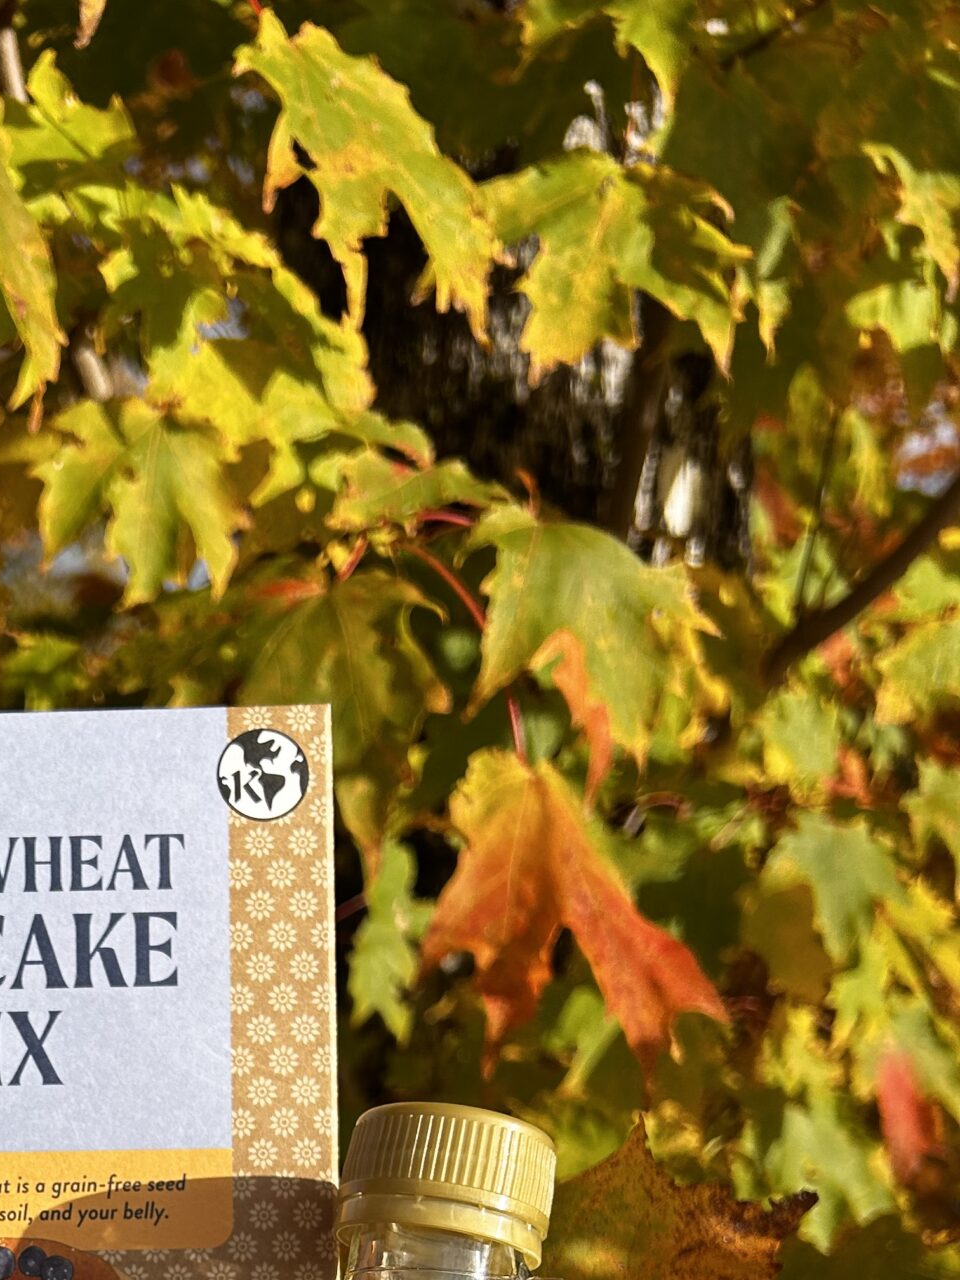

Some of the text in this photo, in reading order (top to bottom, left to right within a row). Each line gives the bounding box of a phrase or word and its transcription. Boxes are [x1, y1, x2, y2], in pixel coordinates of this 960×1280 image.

[16, 1176, 30, 1194] is
[35, 1182, 46, 1194] a
[51, 1173, 142, 1199] grain-free
[146, 1173, 187, 1192] seed
[39, 1203, 73, 1222] and
[77, 1206, 118, 1229] your
[123, 1201, 169, 1227] belly.
